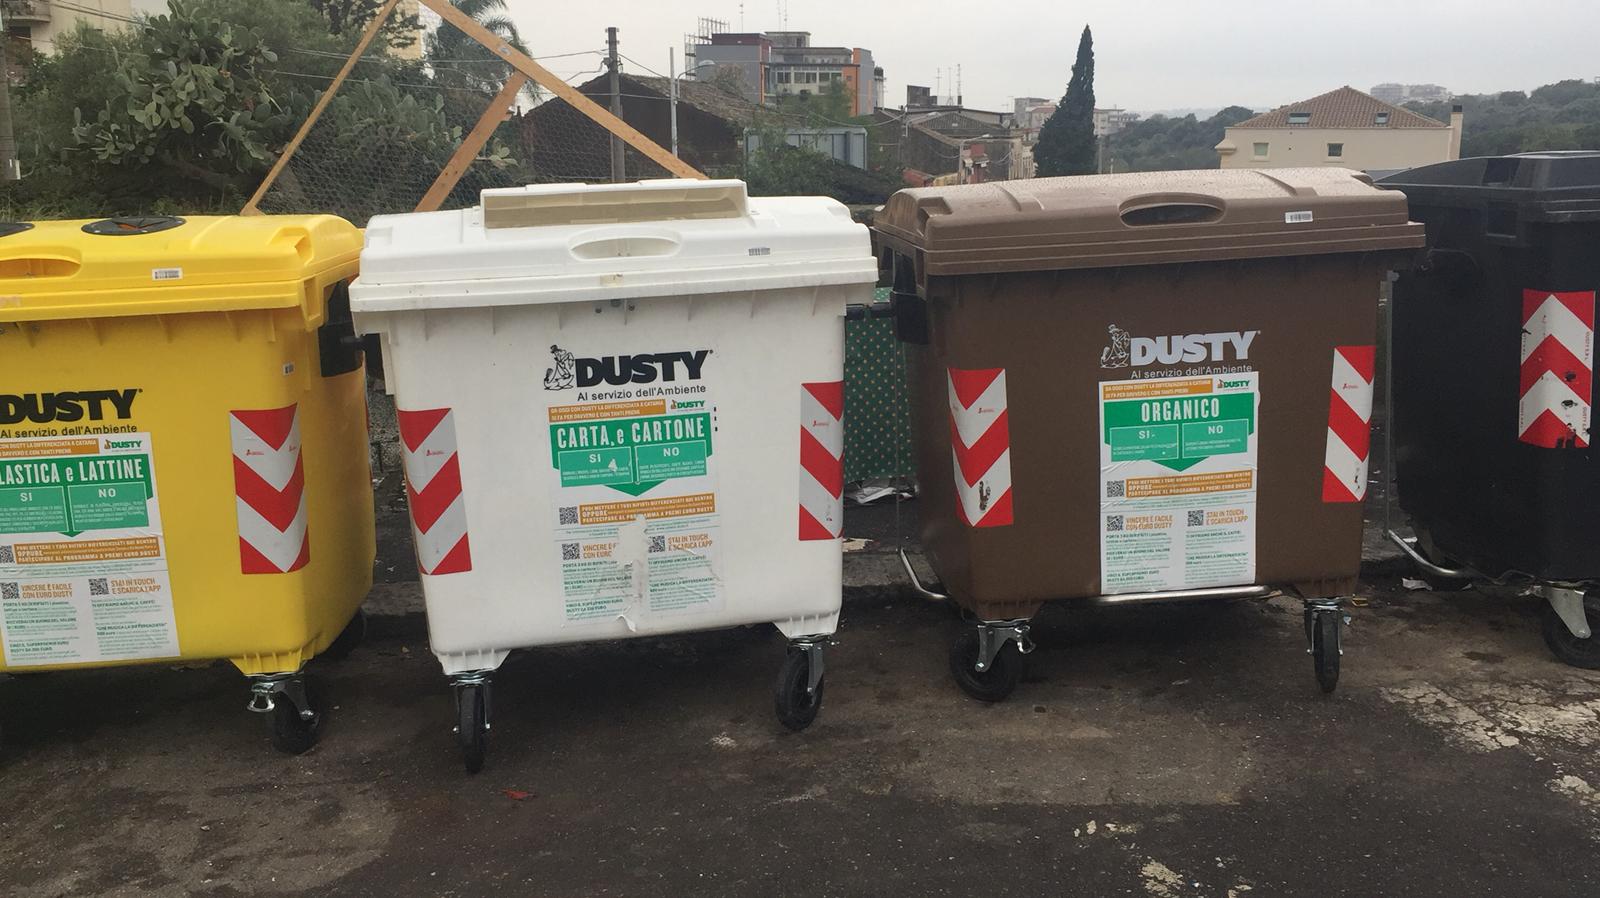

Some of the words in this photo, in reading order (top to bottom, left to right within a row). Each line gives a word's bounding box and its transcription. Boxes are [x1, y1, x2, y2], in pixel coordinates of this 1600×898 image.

[1130, 331, 1256, 366] DUSTY
[575, 350, 709, 388] DUSTY
[1130, 370, 1142, 379] Al
[1144, 368, 1182, 378] servizio
[1185, 365, 1252, 376] dell'Ambiente
[1224, 380, 1250, 388] DUSTY
[577, 392, 588, 402] Al
[592, 388, 632, 400] servizio
[636, 385, 706, 397] dell'Ambiente
[0, 389, 138, 424] DUSTY
[677, 400, 705, 409] DUSTY
[1141, 398, 1220, 422] ORGANICO
[0, 430, 11, 438] Al
[16, 427, 58, 438] servizio
[62, 424, 137, 436] dell'Ambiente
[616, 428, 624, 445] e
[632, 417, 704, 442] CARTONE
[1208, 426, 1223, 434] NO
[111, 440, 142, 448] DUSTY
[589, 454, 600, 463] SI
[664, 447, 680, 457] NO
[0, 463, 60, 485] LASTICA
[66, 466, 74, 482] e
[80, 458, 144, 482] LATTINE
[20, 492, 32, 502] SI
[98, 488, 116, 498] NO
